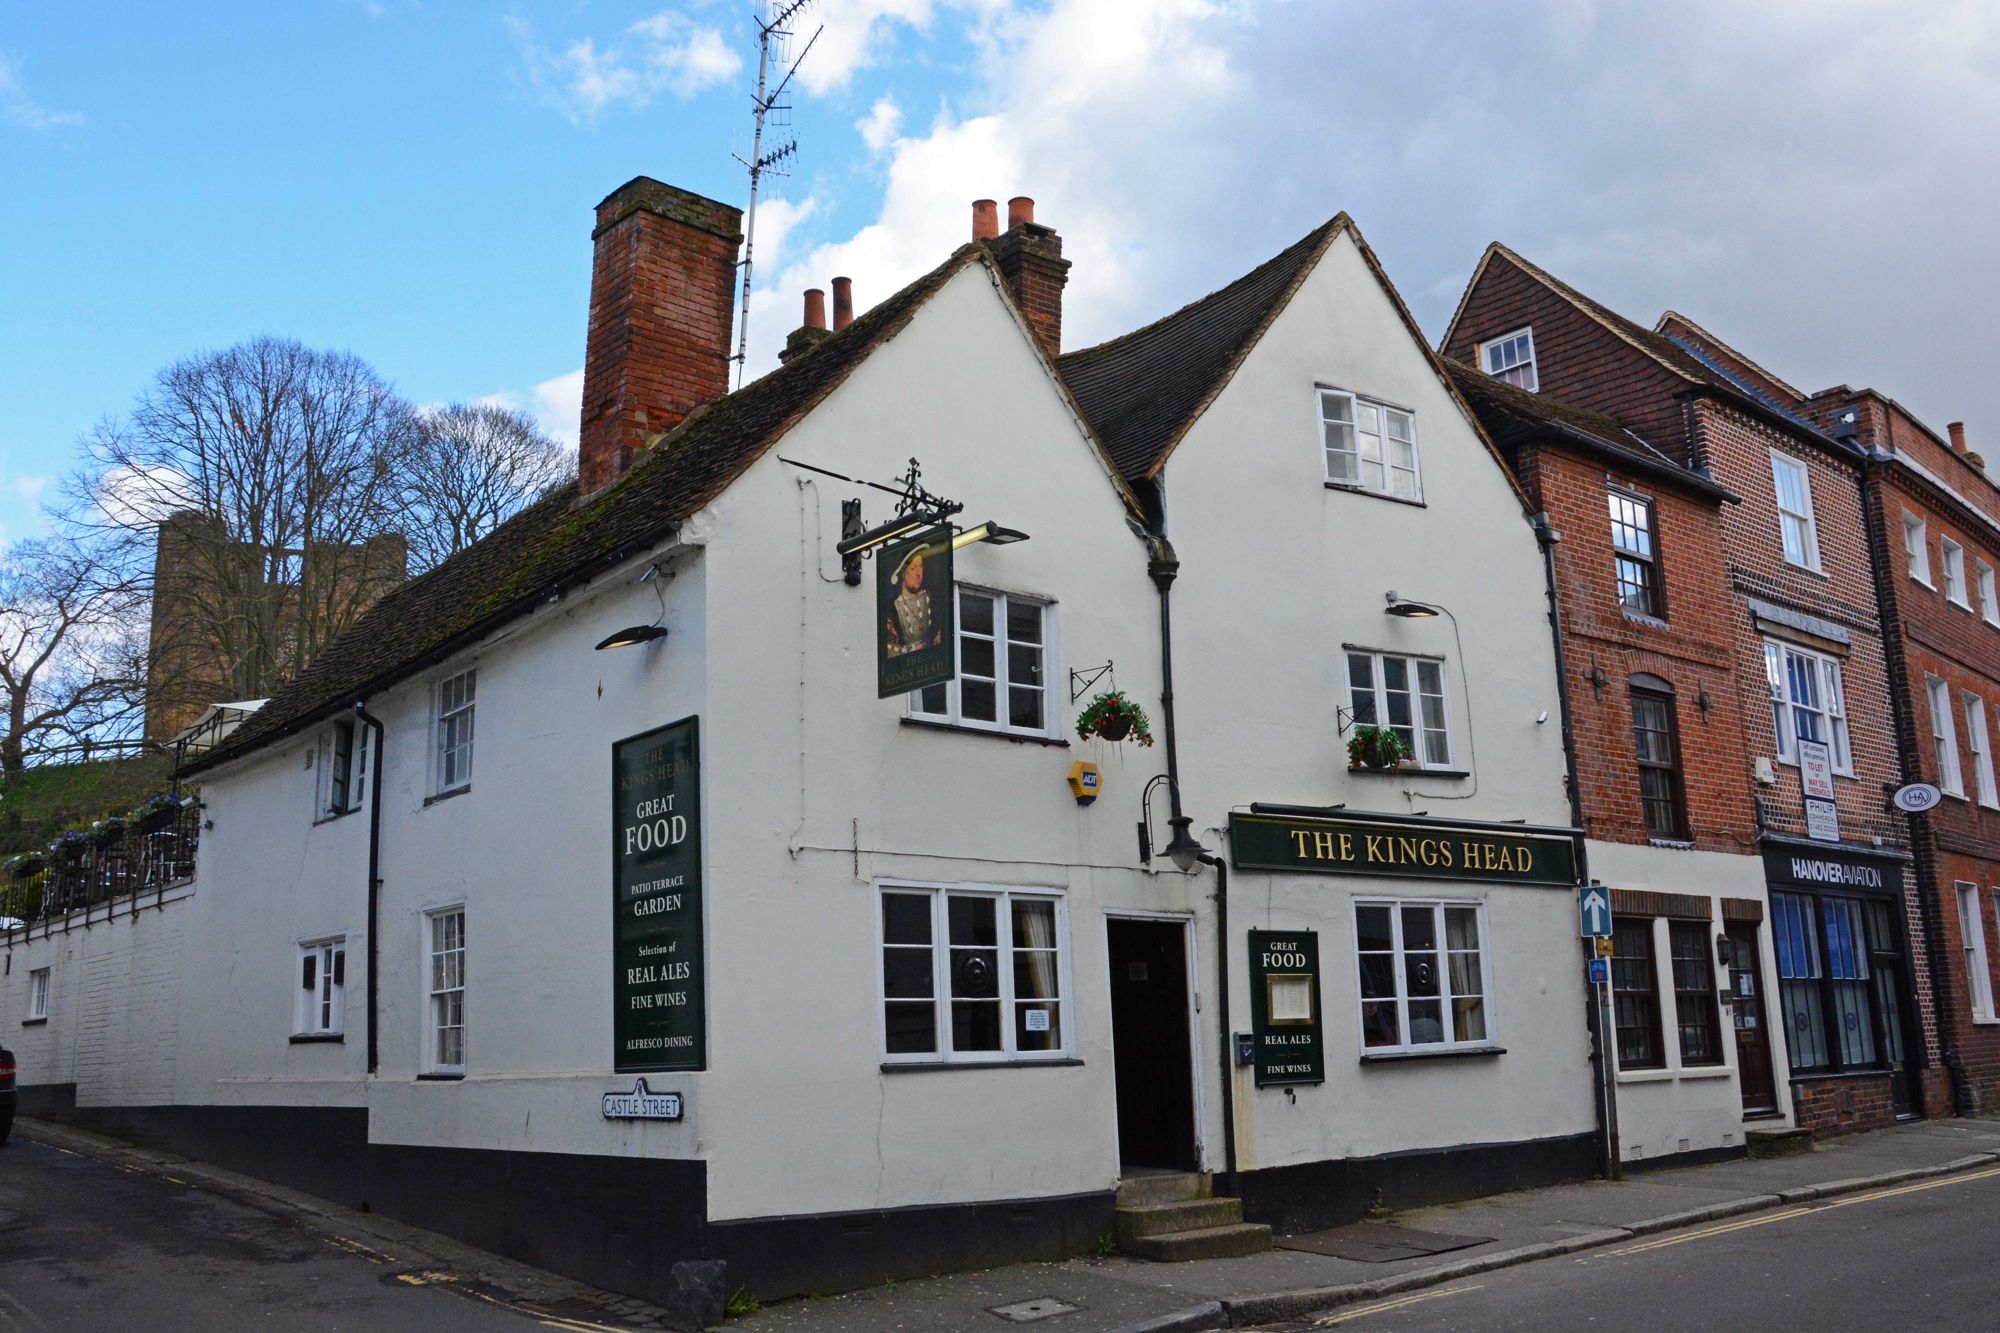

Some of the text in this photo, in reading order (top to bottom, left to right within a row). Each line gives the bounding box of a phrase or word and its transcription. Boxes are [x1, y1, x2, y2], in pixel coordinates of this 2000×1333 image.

[644, 747, 664, 764] THE
[622, 759, 690, 791] KINGS HEAD
[1808, 761, 1824, 772] TO LET
[1083, 774, 1097, 785] ADT
[636, 794, 675, 819] GREAT
[1810, 802, 1833, 813] PHILIP
[625, 815, 687, 855] FOOD
[1291, 830, 1533, 873] THE KINGS HEAD
[631, 875, 684, 895] PATIO TERRACE
[634, 894, 682, 917] GARDEN
[638, 941, 677, 956] Selection of
[1270, 942, 1297, 951] GREAT
[1262, 953, 1306, 968] FOOD
[627, 961, 690, 984] REAL ALES
[631, 991, 687, 1009] FINE WINES
[626, 1035, 693, 1050] ALFRESCO DINING
[1265, 1034, 1311, 1045] REAL ALES
[1267, 1064, 1312, 1074] FINE WINES
[604, 1098, 678, 1116] CASTLE STREET
